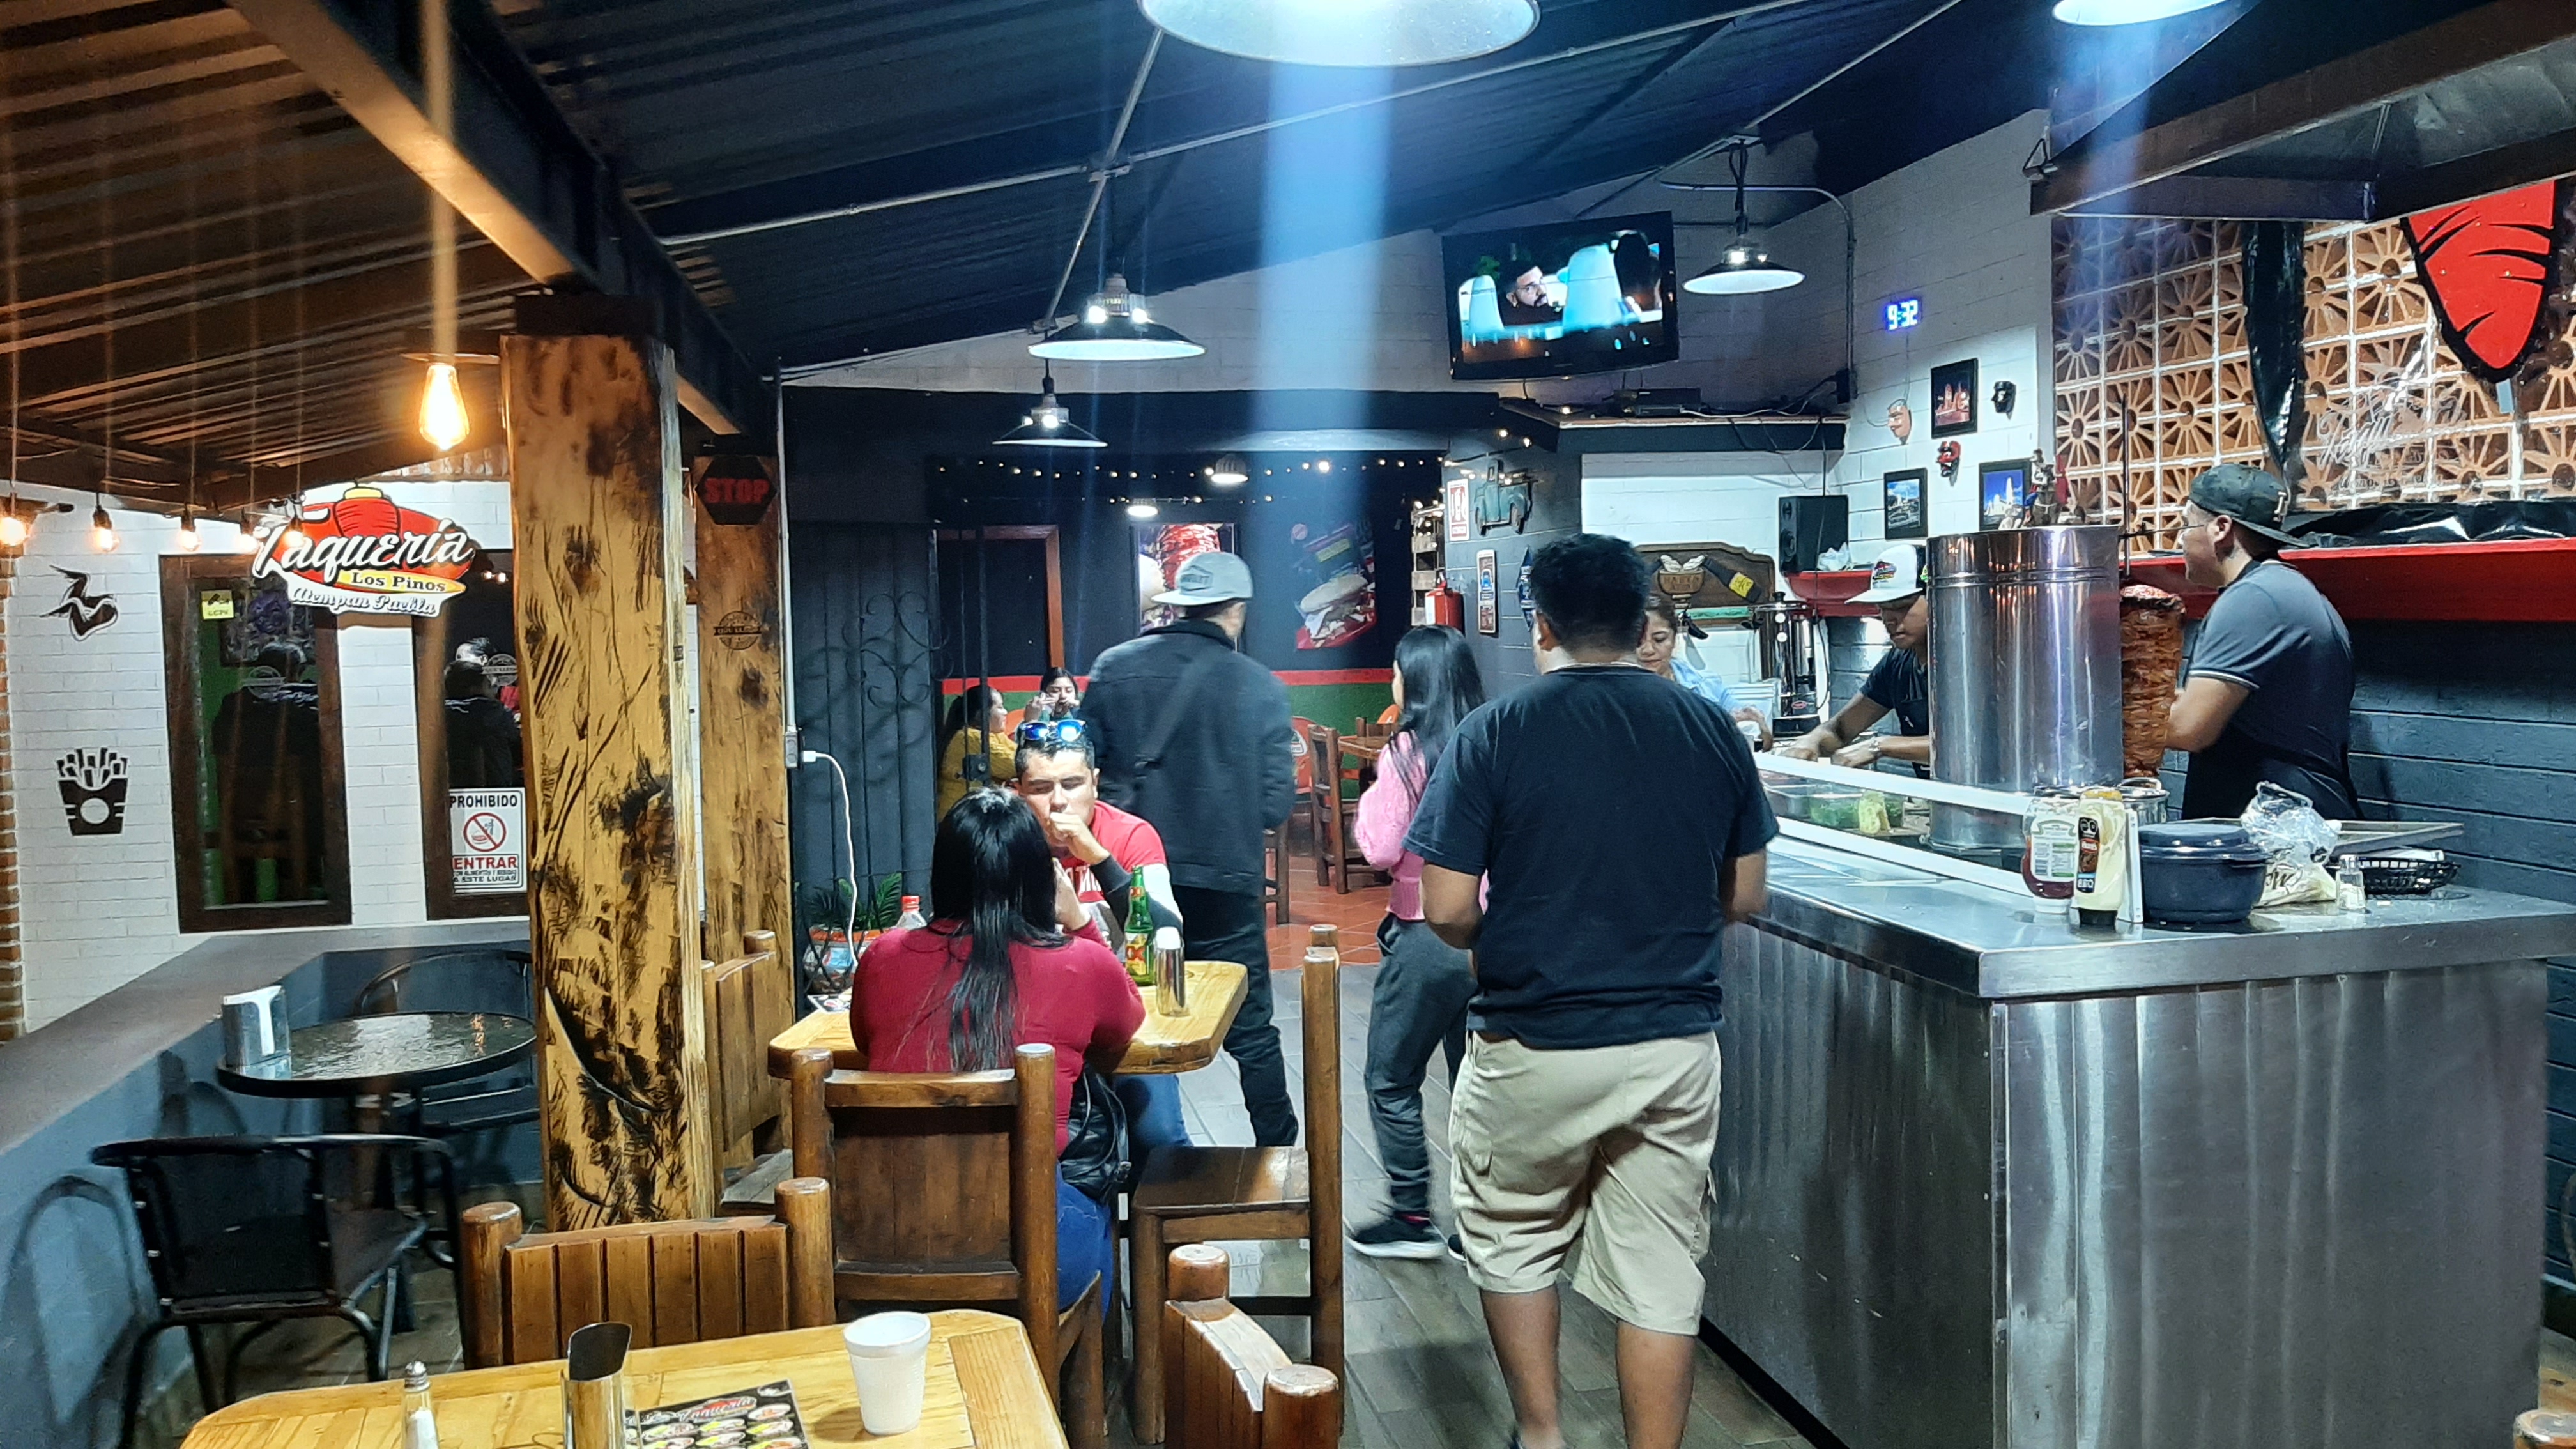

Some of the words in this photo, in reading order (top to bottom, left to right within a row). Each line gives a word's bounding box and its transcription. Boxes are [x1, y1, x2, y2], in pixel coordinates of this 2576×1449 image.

[1887, 300, 1918, 330] 9:32
[705, 477, 770, 503] STOP
[252, 507, 475, 583] Taquería
[351, 572, 385, 586] Los
[392, 576, 446, 592] Pinos
[450, 795, 518, 808] PROHIBIDO
[454, 857, 518, 870] ENTRAR
